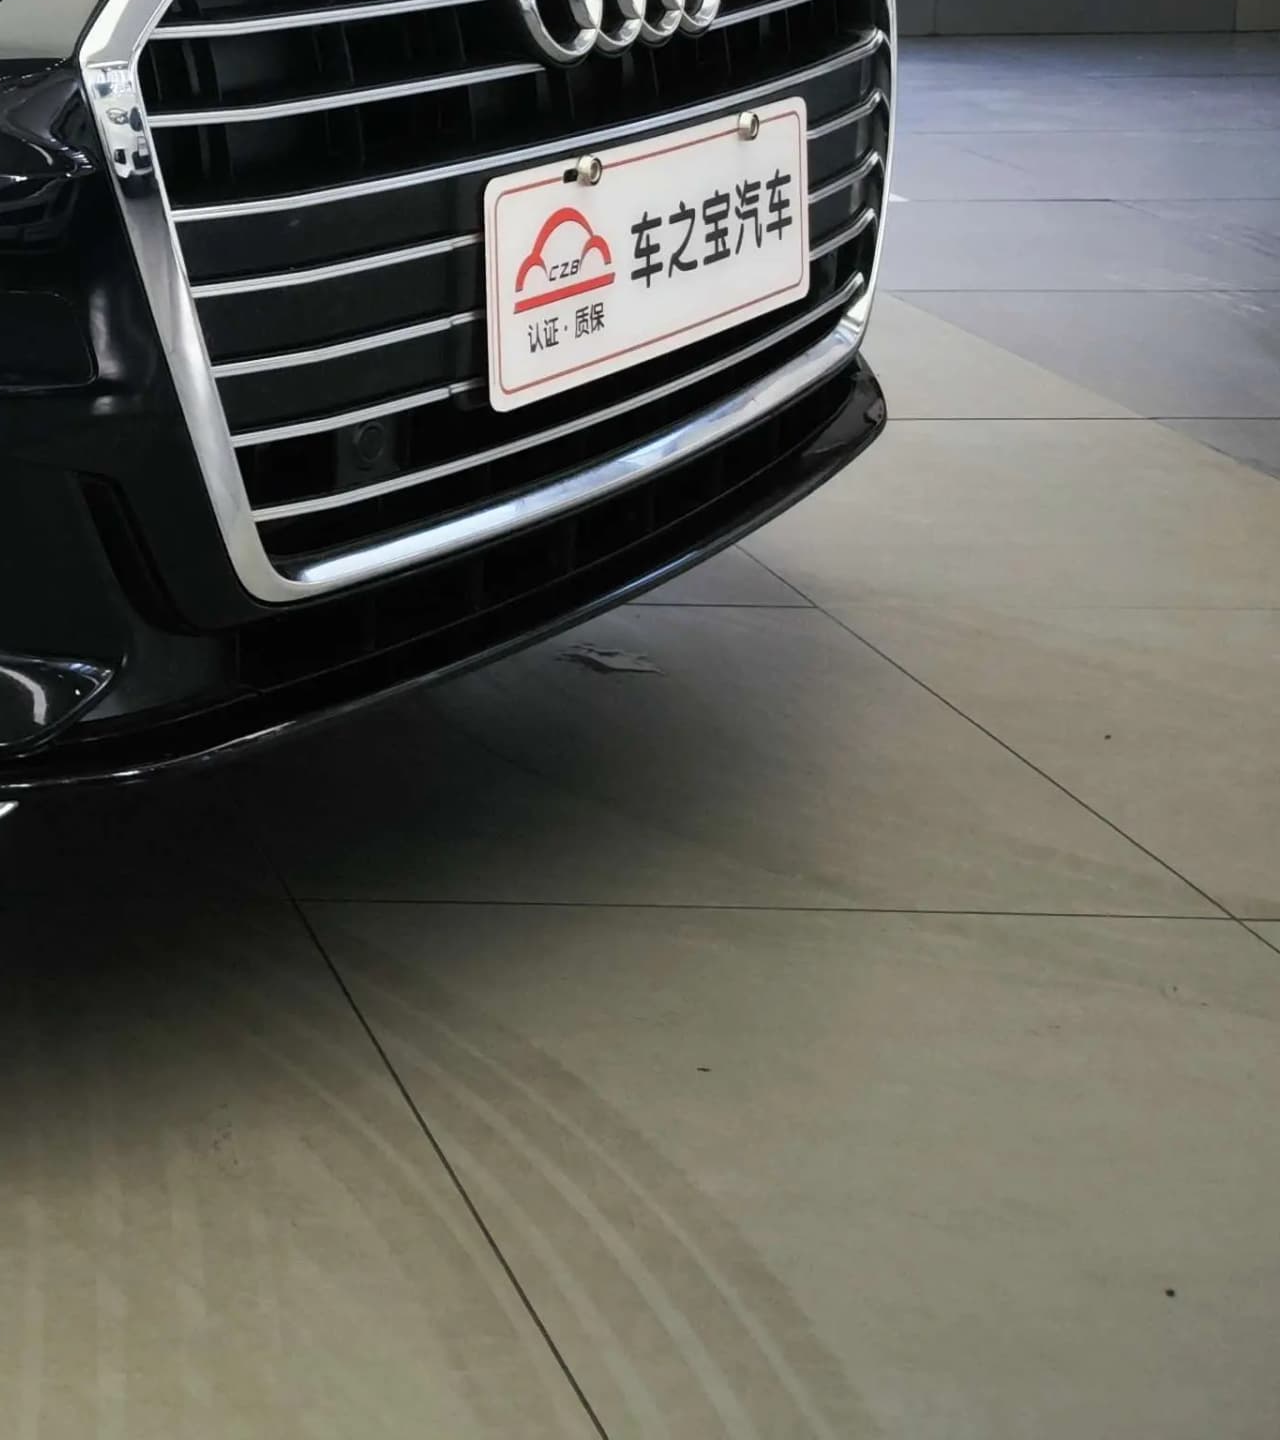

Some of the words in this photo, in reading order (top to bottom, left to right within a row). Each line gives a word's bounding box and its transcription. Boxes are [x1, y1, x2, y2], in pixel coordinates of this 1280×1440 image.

[630, 169, 793, 288] 车之宝汽车
[549, 259, 580, 282] CZB
